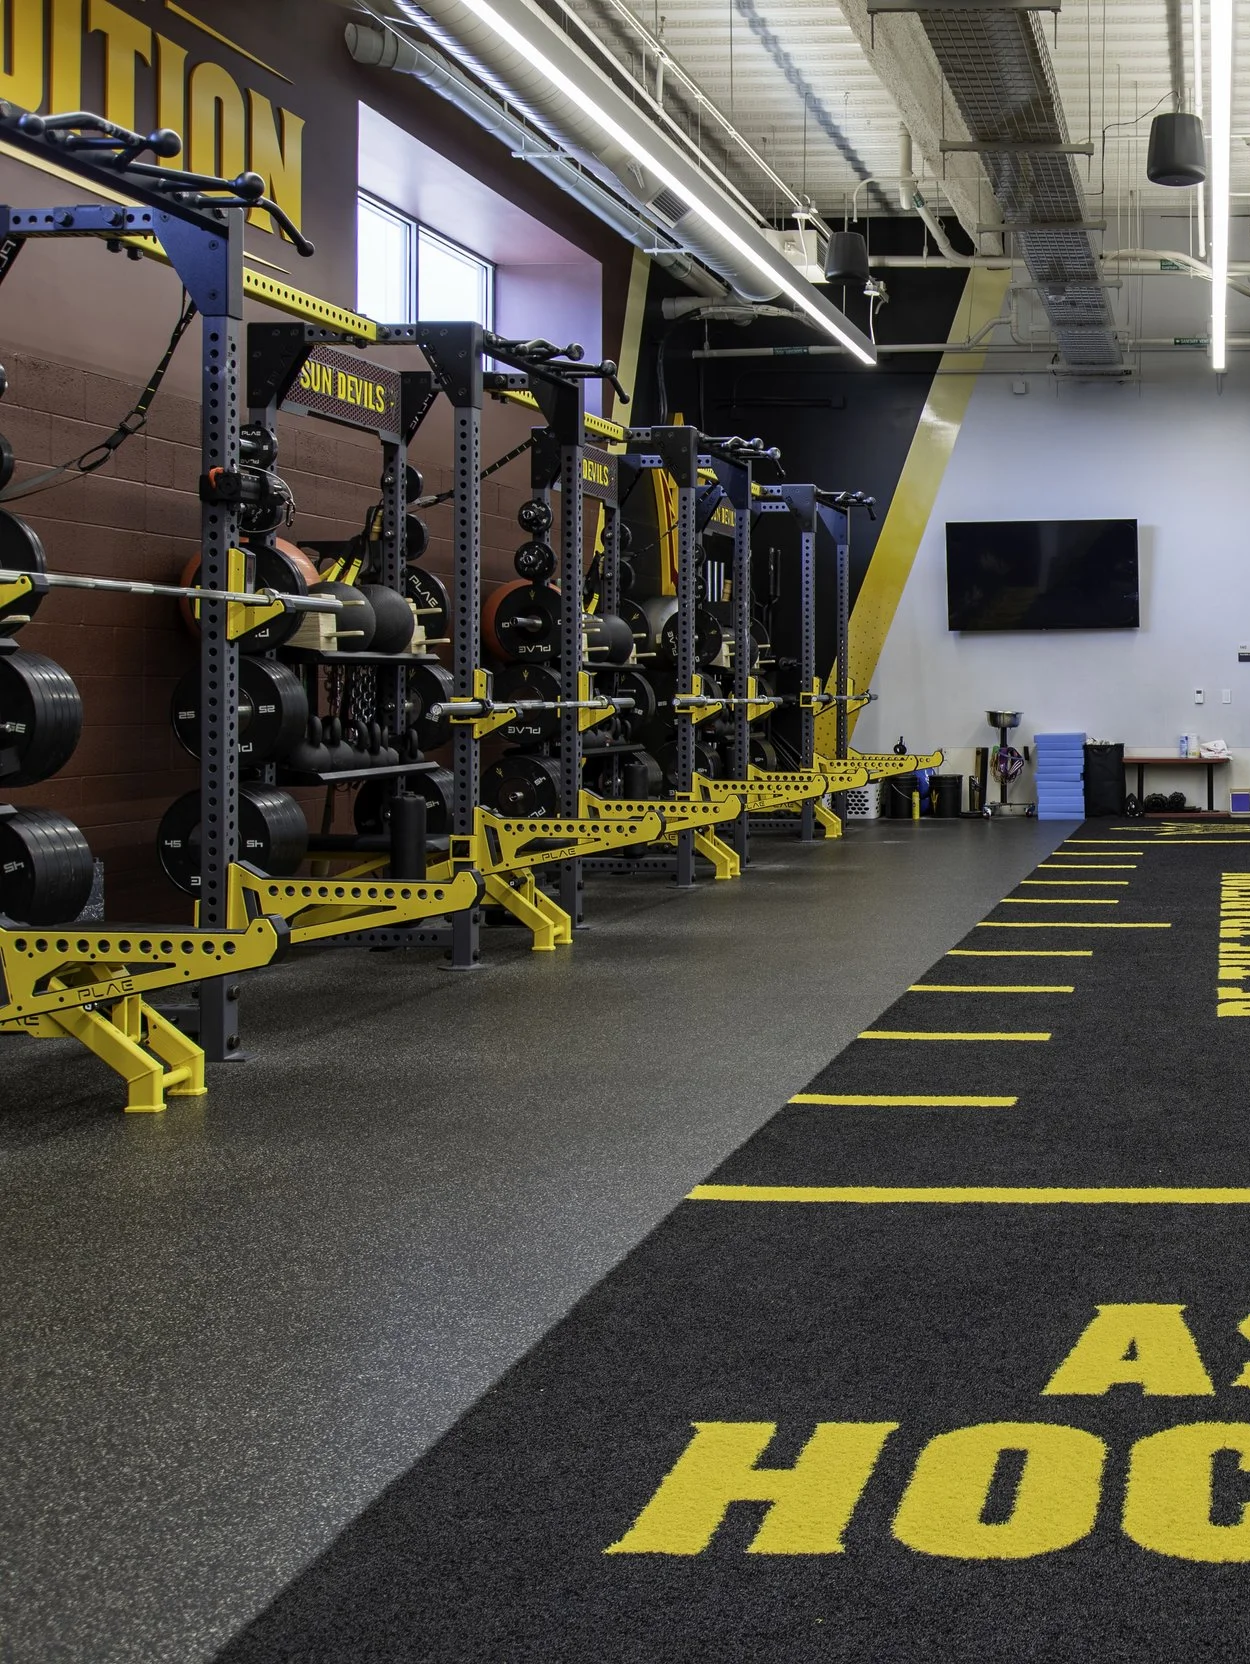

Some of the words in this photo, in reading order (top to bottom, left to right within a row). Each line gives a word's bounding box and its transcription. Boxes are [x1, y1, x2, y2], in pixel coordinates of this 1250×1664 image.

[300, 360, 332, 396] SUN
[337, 371, 385, 413] DEVILS
[583, 459, 609, 486] DEVILS
[409, 575, 439, 608] PLAE
[519, 645, 551, 653] PLAE
[179, 710, 195, 719] 25
[508, 726, 541, 734] PLAE
[165, 840, 182, 848] 45
[541, 848, 576, 861] PLAE
[78, 979, 134, 1001] PLAE
